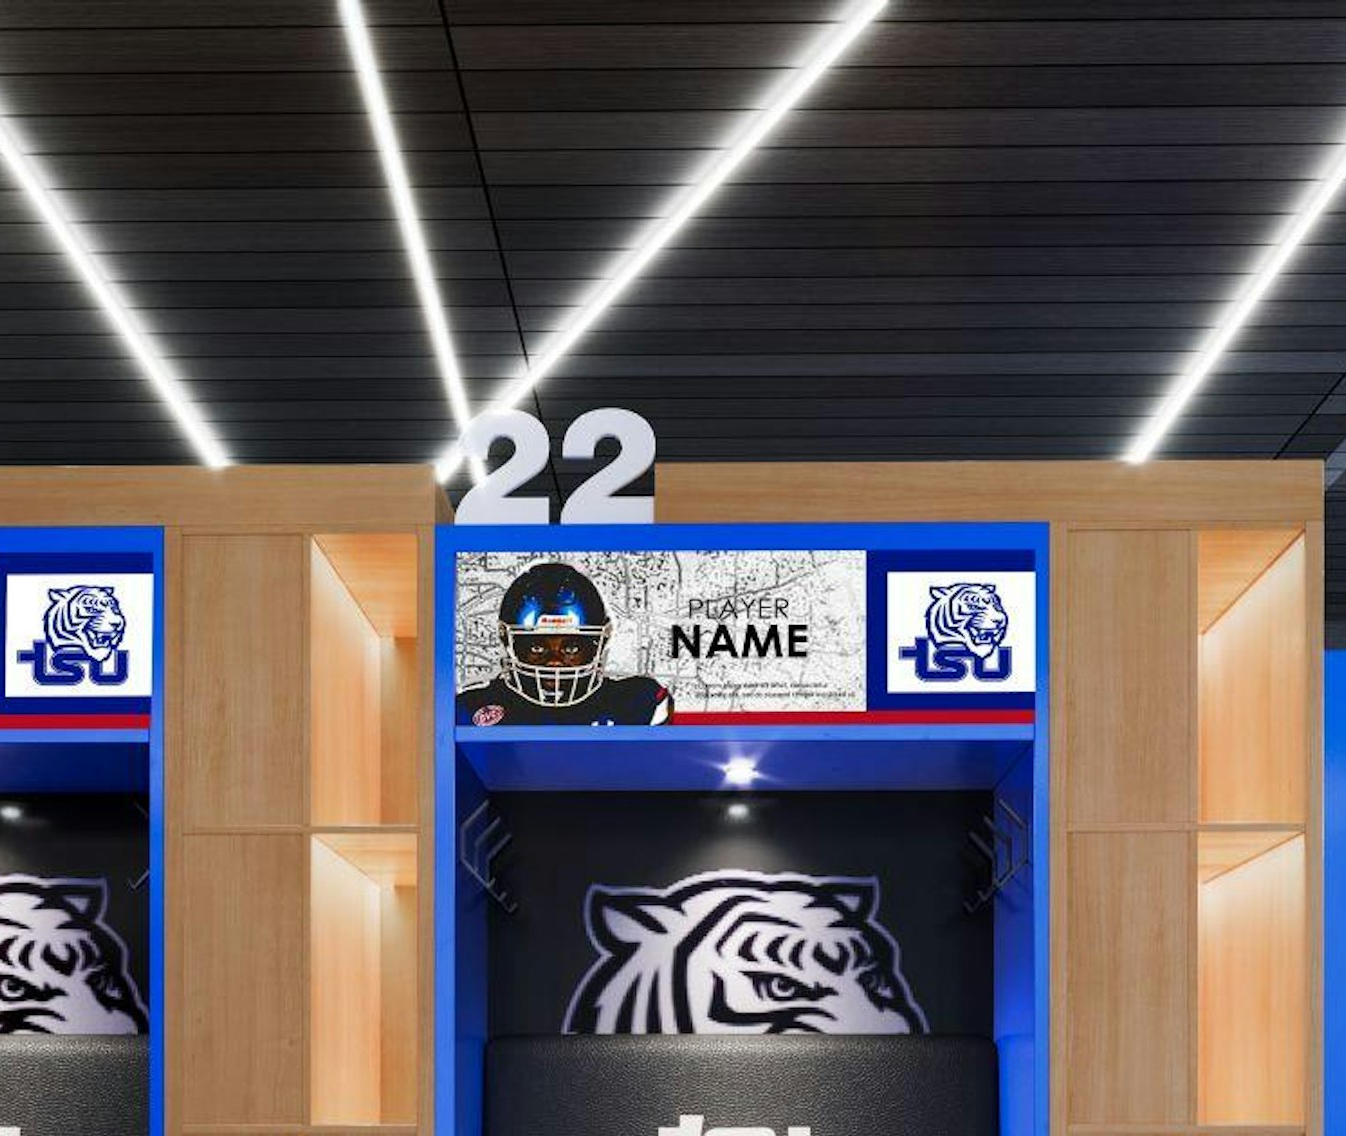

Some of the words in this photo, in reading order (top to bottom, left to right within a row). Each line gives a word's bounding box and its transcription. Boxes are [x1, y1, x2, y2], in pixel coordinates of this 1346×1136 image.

[454, 407, 656, 525] 22
[688, 598, 790, 620] PLAYER
[670, 623, 809, 659] NAME
